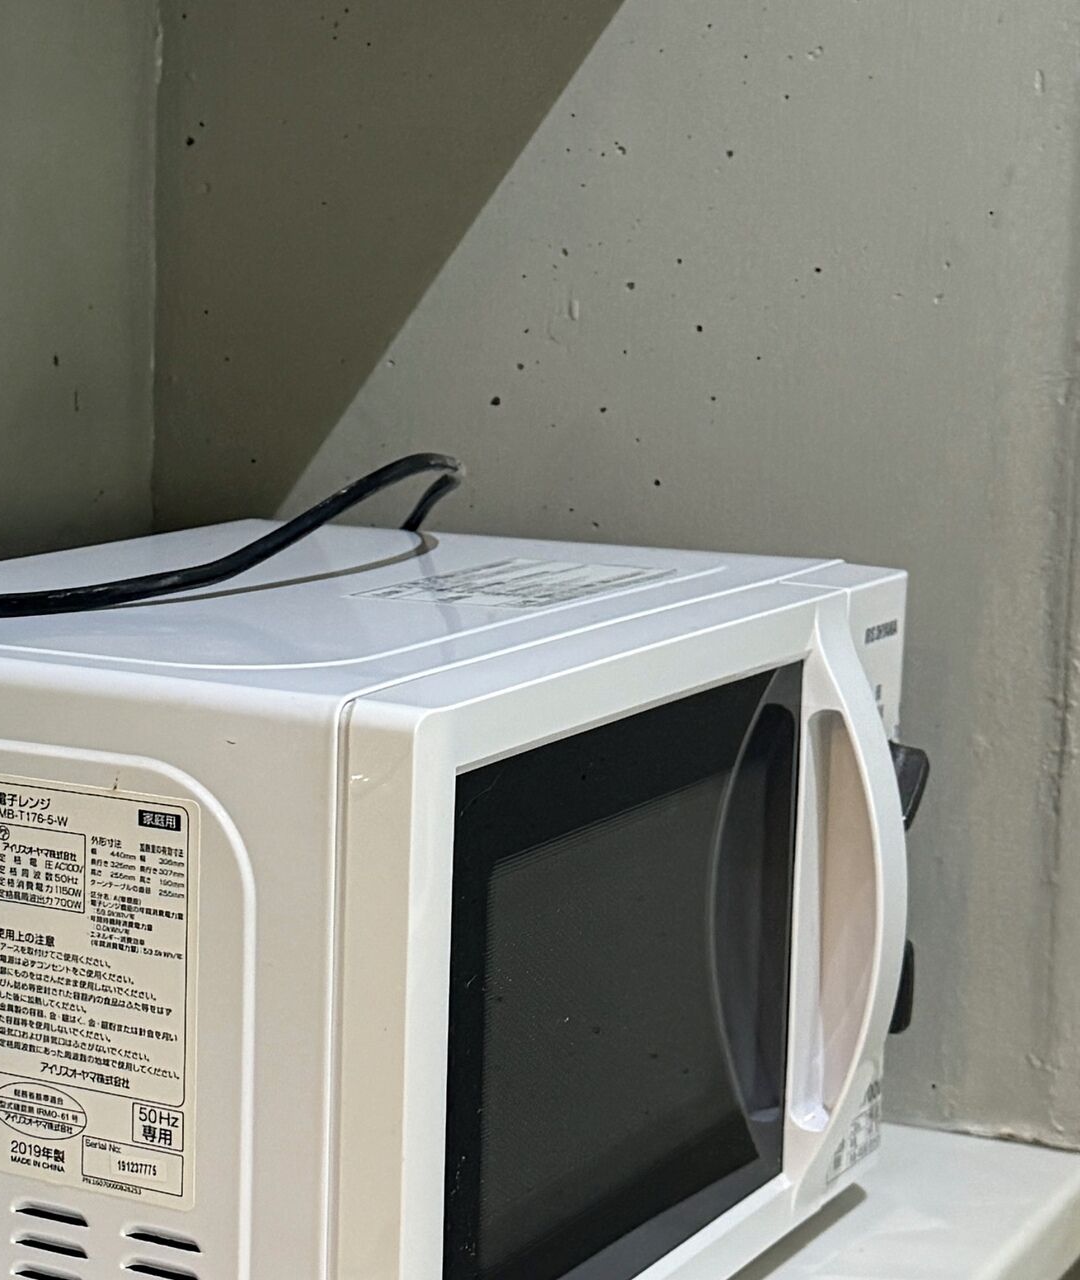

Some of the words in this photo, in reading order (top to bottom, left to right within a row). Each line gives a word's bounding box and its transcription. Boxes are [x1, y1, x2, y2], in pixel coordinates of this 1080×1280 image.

[142, 811, 176, 828] 家庭用
[2, 841, 76, 862] アイリスオーヤマ株式会社
[40, 1059, 129, 1092] アイリスオーヤマ株式会社
[4, 1110, 72, 1136] アイリスオーヤマ株式会社
[142, 1123, 172, 1147] 専用
[11, 1137, 64, 1165] 2019年製
